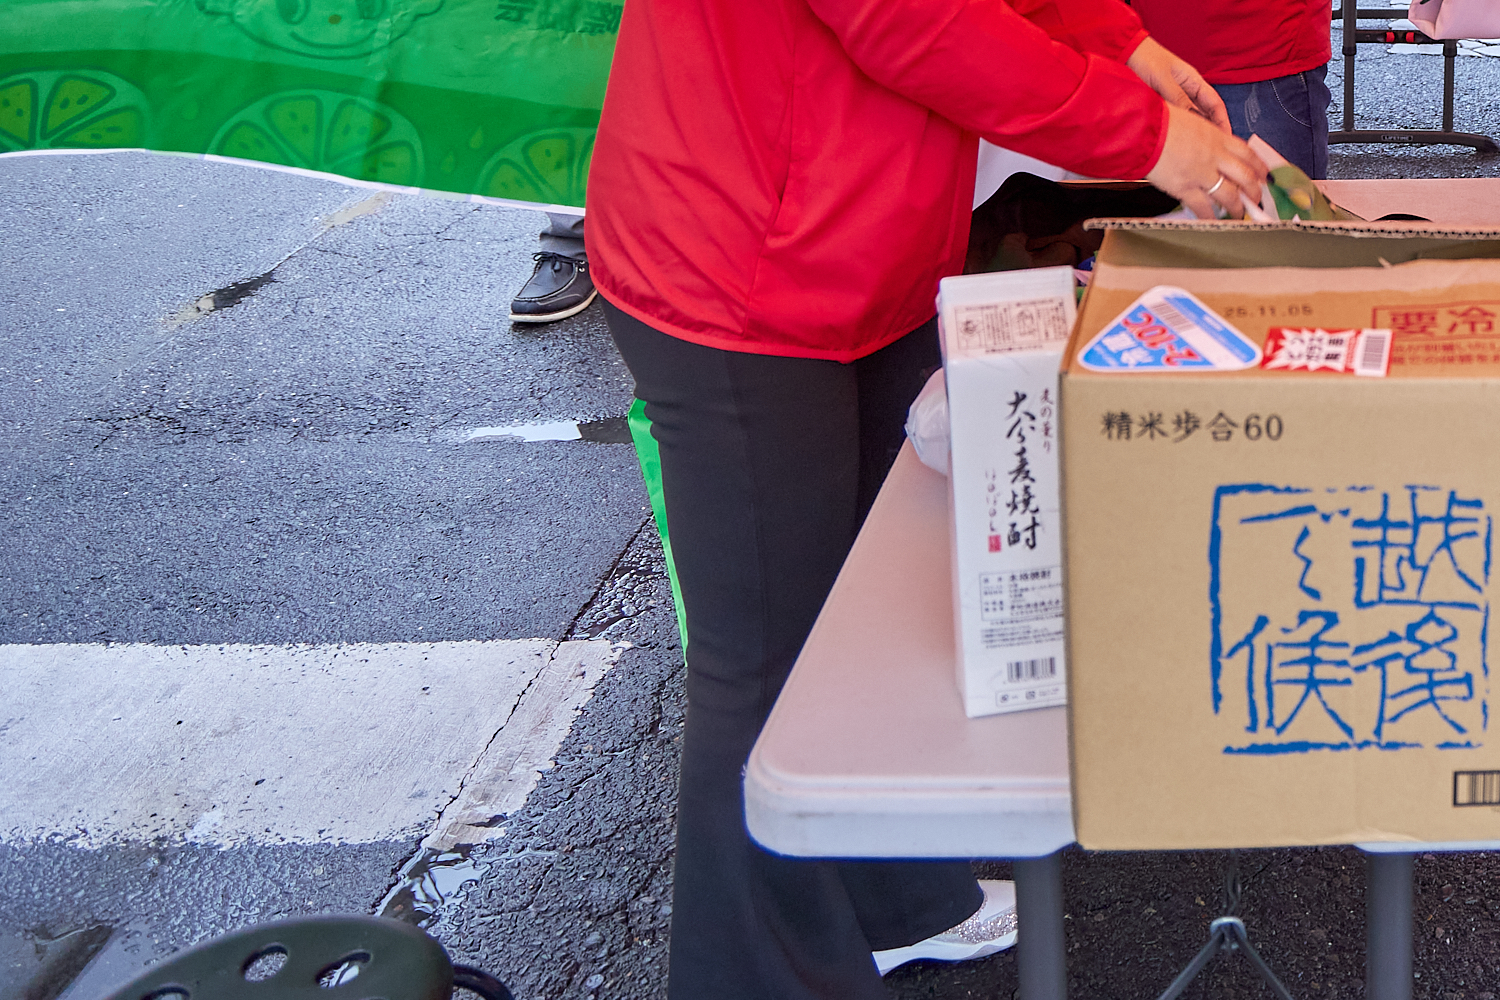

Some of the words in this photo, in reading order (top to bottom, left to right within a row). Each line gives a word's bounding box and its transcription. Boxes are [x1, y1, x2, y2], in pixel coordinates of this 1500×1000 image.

[1005, 391, 1040, 550] 大分麦焼酎
[1101, 409, 1285, 443] 精米歩合60
